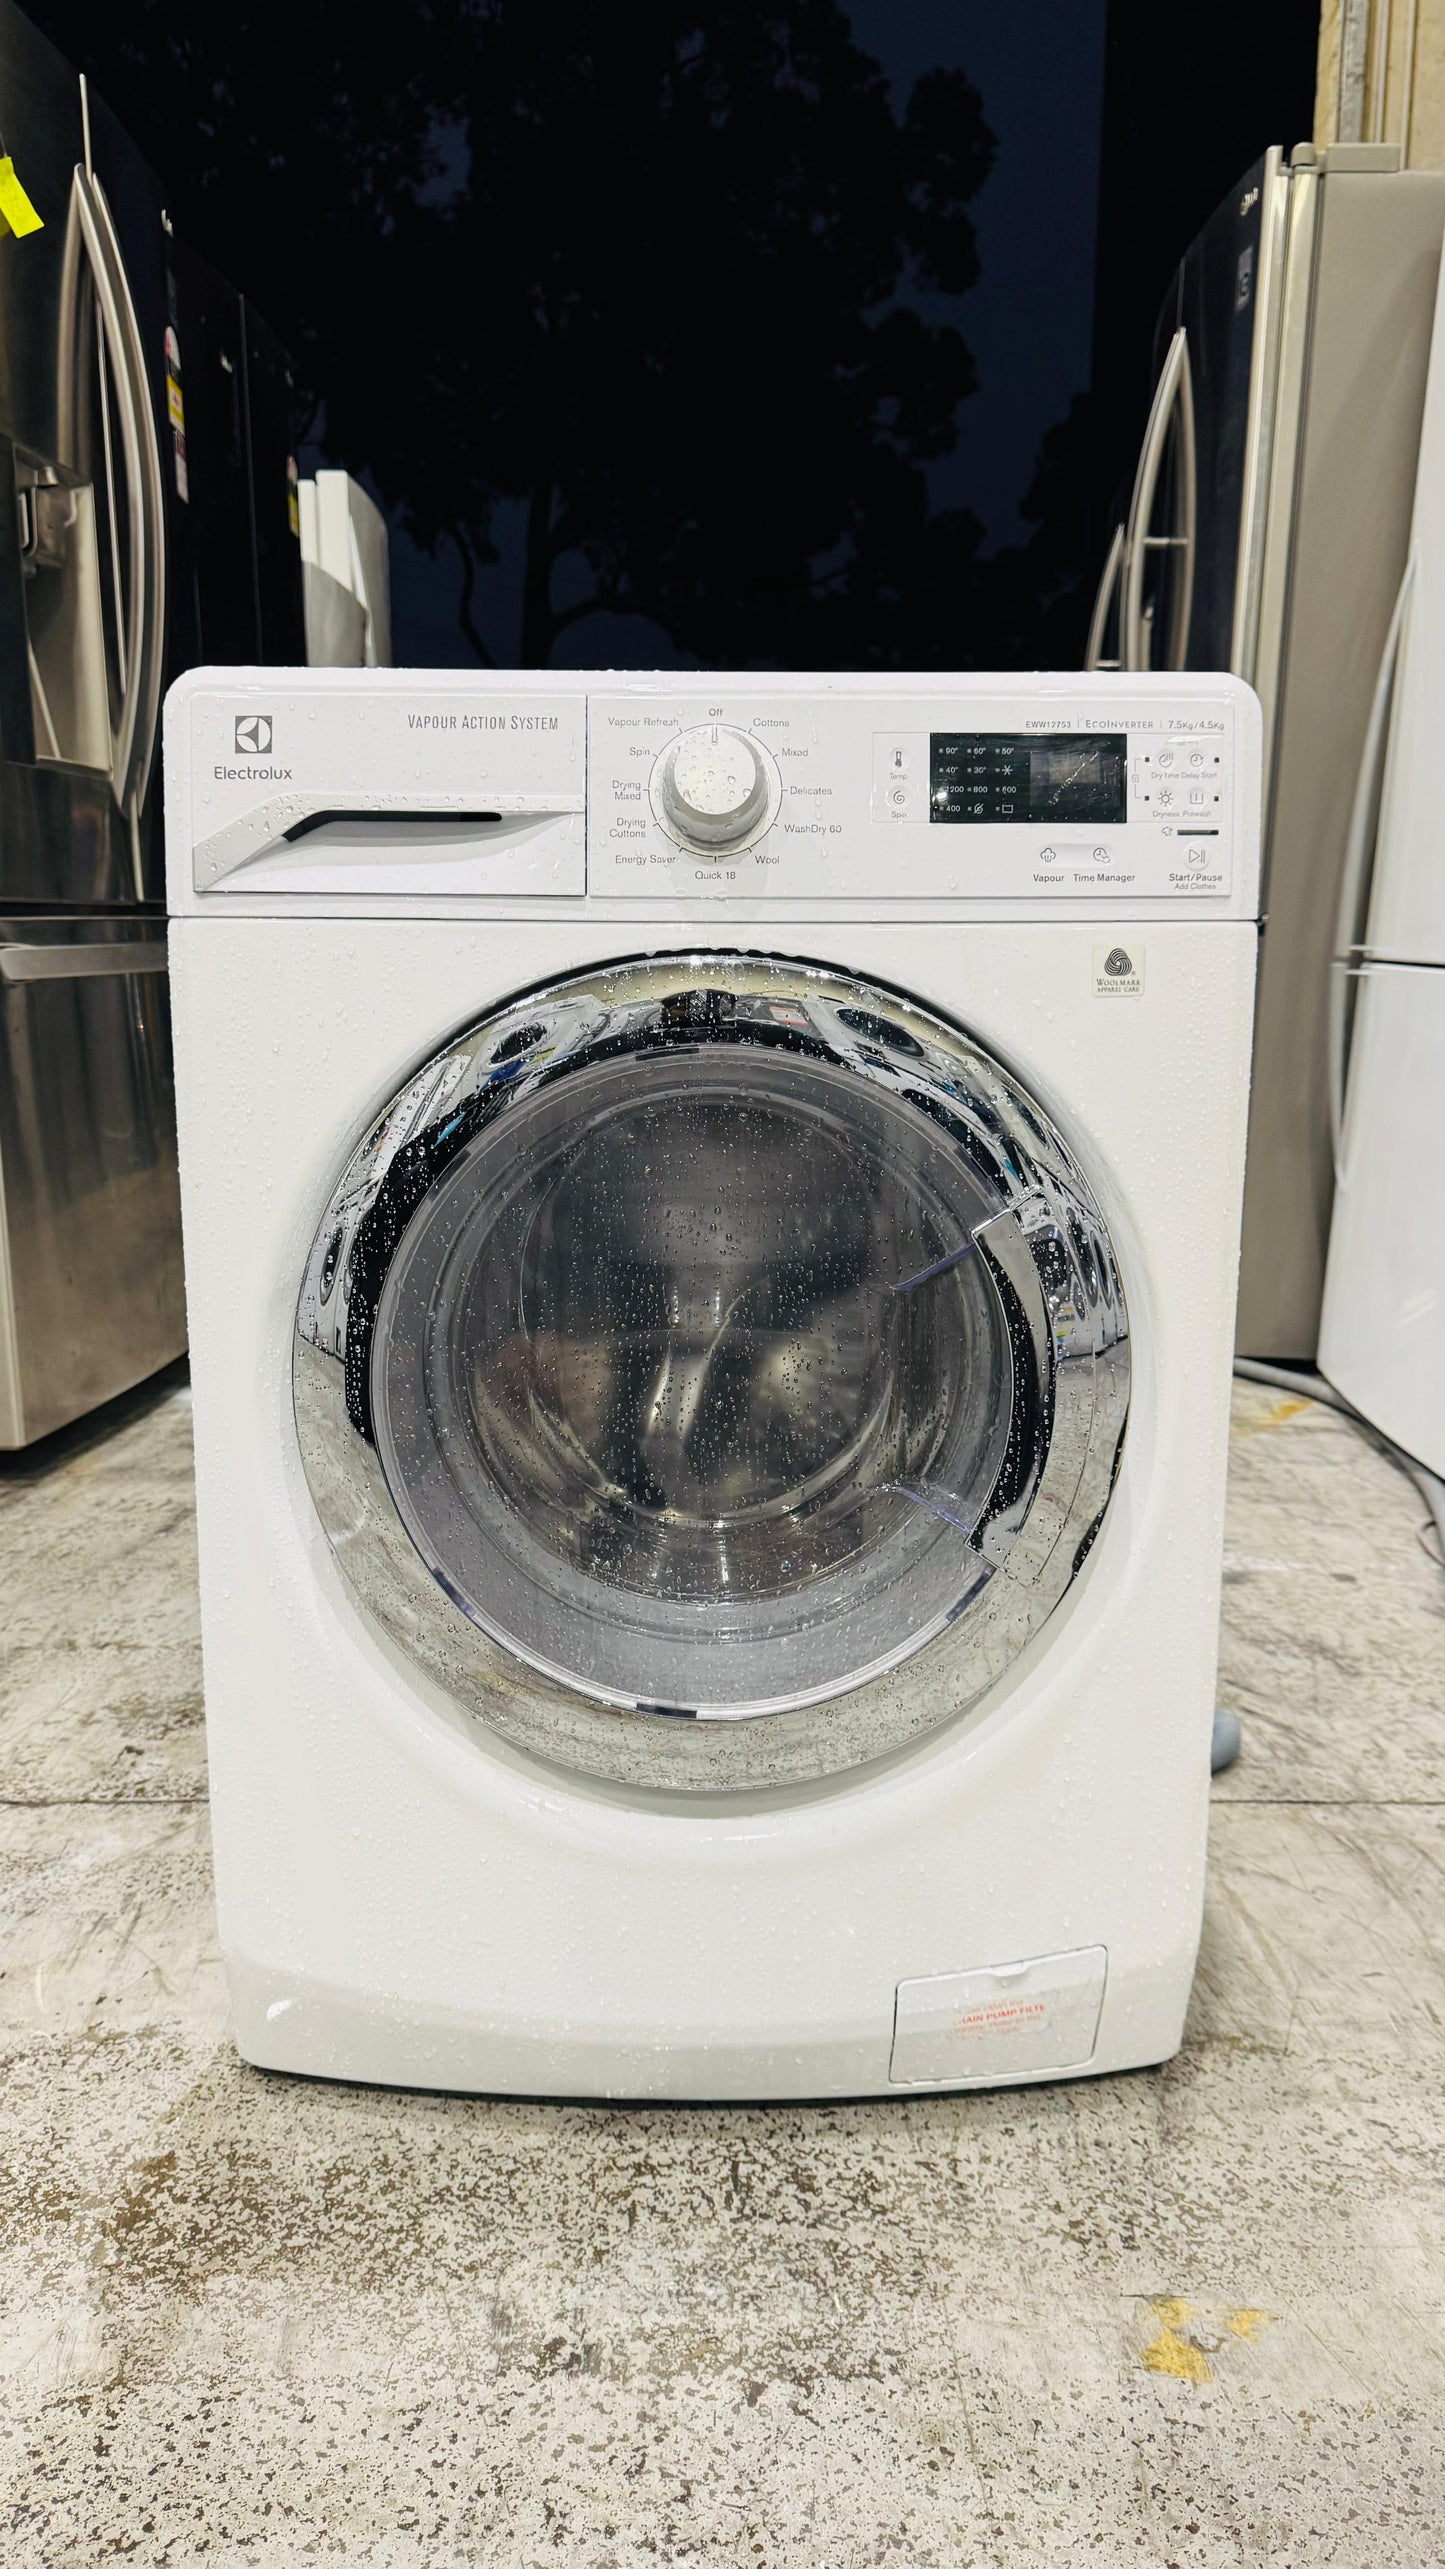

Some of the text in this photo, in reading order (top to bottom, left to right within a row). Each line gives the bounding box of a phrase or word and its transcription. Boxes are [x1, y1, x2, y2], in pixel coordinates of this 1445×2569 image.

[708, 708, 723, 718] Off
[408, 714, 559, 731] VAPOUR ACTION SYSTEM
[608, 717, 679, 728] Vapour Refresh
[753, 718, 790, 727] Cottons
[629, 746, 650, 757] Spin
[781, 748, 809, 757] Mixed
[214, 766, 292, 781] Electrolux
[612, 780, 641, 791] Drying
[790, 785, 832, 795] Delicates
[614, 791, 641, 800] Mixed
[945, 804, 961, 812] 400
[616, 817, 646, 829] Drying
[609, 829, 646, 838] Cottons
[784, 824, 842, 835] WashDry 60
[615, 855, 676, 865] Energy Saver
[755, 855, 780, 864] Wool
[695, 870, 736, 880] Quick 18
[1033, 873, 1065, 884] Vapour
[1074, 873, 1135, 884] Time Manager
[1169, 873, 1223, 882] Start/Pause
